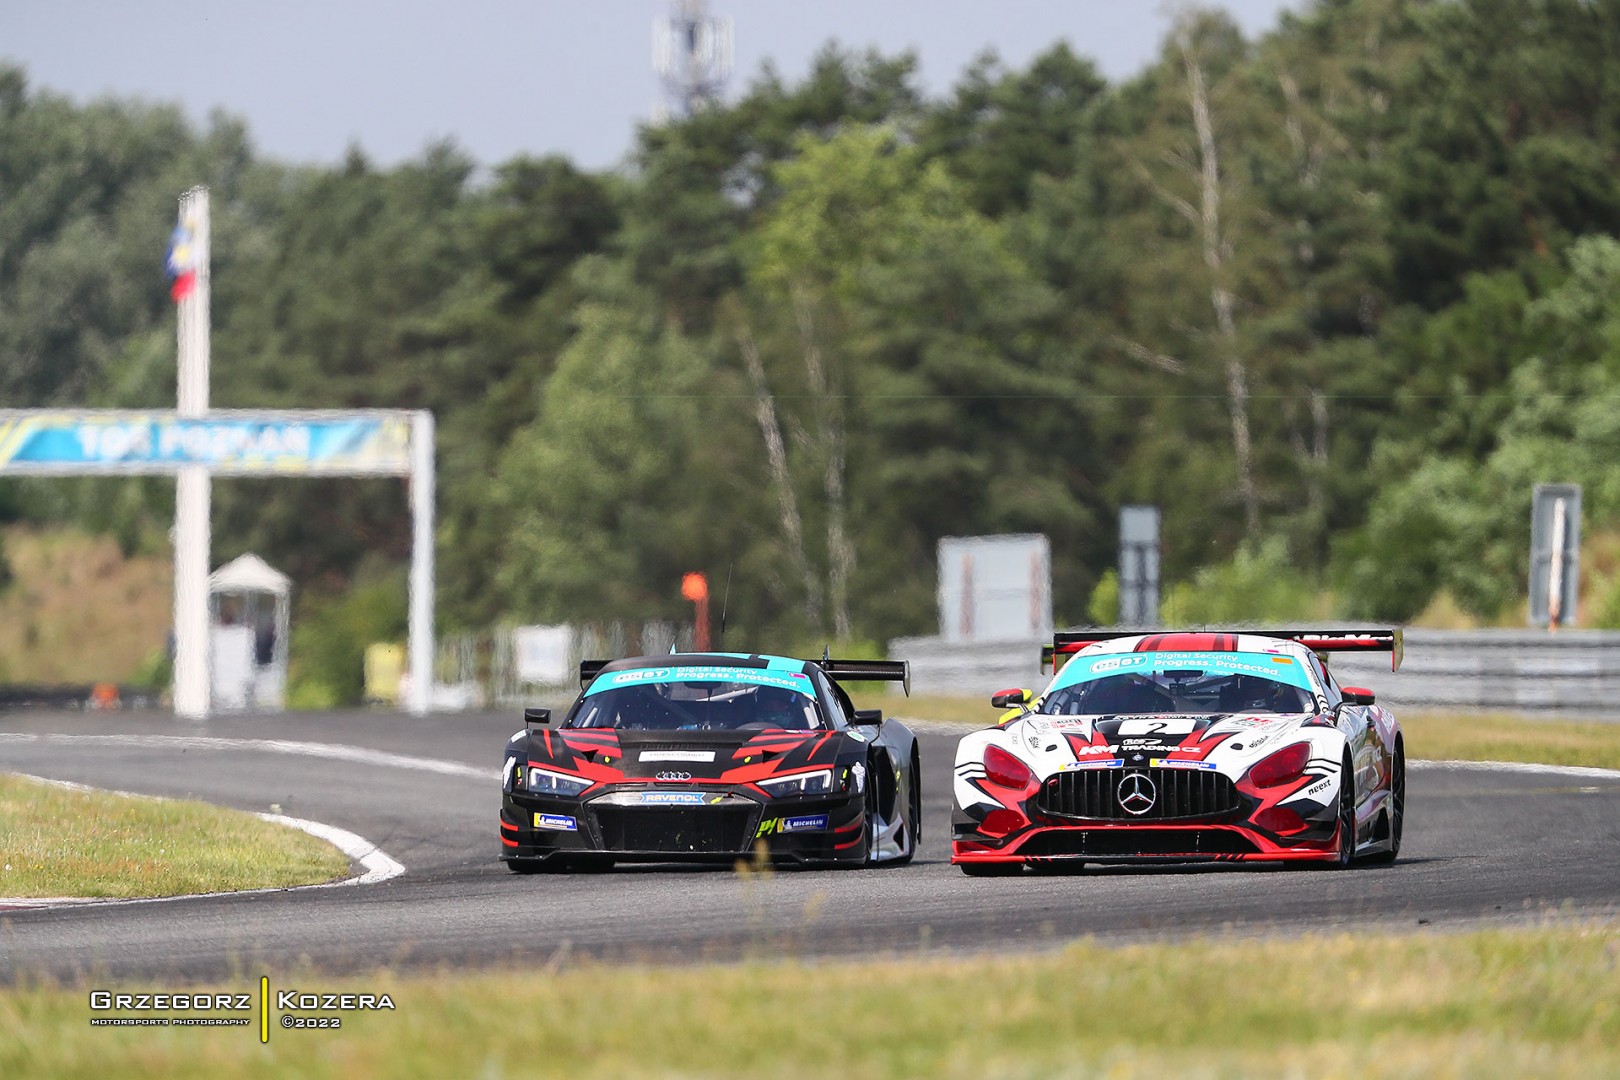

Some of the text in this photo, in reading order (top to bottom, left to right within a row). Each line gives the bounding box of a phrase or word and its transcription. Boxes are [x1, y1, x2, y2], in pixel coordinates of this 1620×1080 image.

[1193, 653, 1238, 661] Security
[714, 667, 757, 675] Security
[1153, 659, 1282, 677] Progress. Protected.
[736, 673, 801, 689] Protected.
[1148, 722, 1168, 735] 2
[1078, 745, 1119, 756] KM
[1308, 779, 1332, 796] neext
[645, 793, 699, 802] RAVENOL
[545, 818, 573, 827] MICHELIN
[792, 819, 824, 827] MICHELIN
